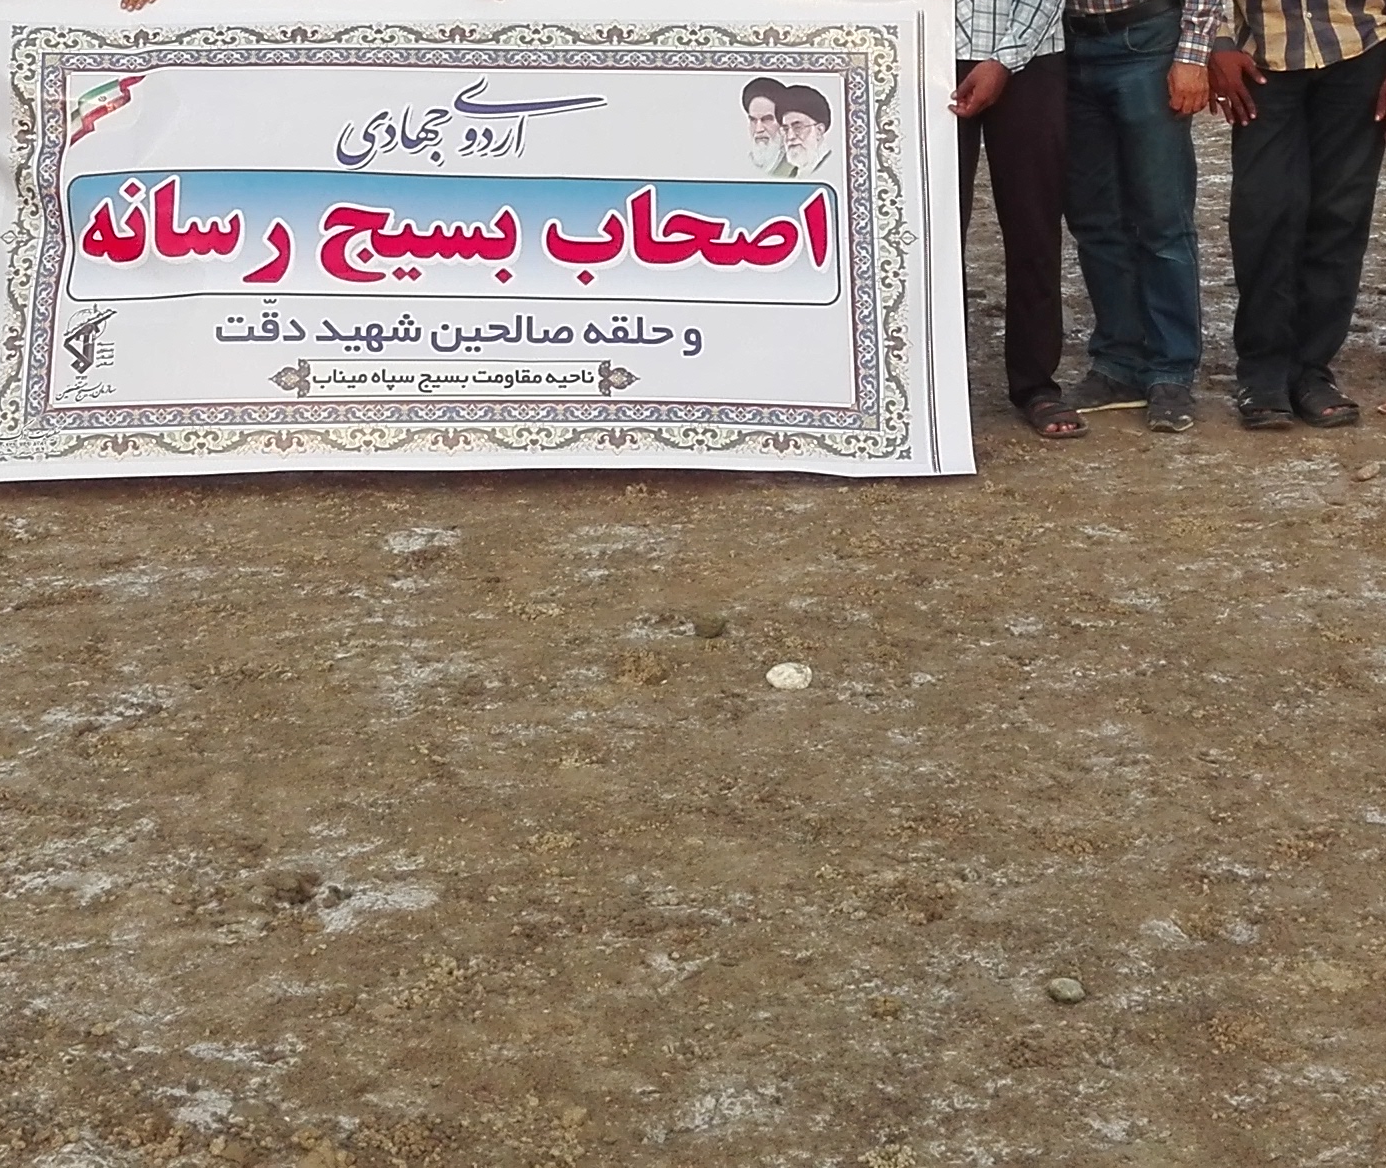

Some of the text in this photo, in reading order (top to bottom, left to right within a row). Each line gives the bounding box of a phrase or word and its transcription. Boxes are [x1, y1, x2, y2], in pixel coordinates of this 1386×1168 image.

[336, 78, 608, 170] اردوی جهادی
[82, 181, 829, 283] اصحاب بسیج رسانه
[315, 313, 423, 353] شهید
[429, 314, 574, 353] صالحین
[583, 315, 674, 345] حلقه
[682, 326, 703, 357] و
[312, 368, 596, 393] ناحیه مقاومت بسیج سپاه میناب
